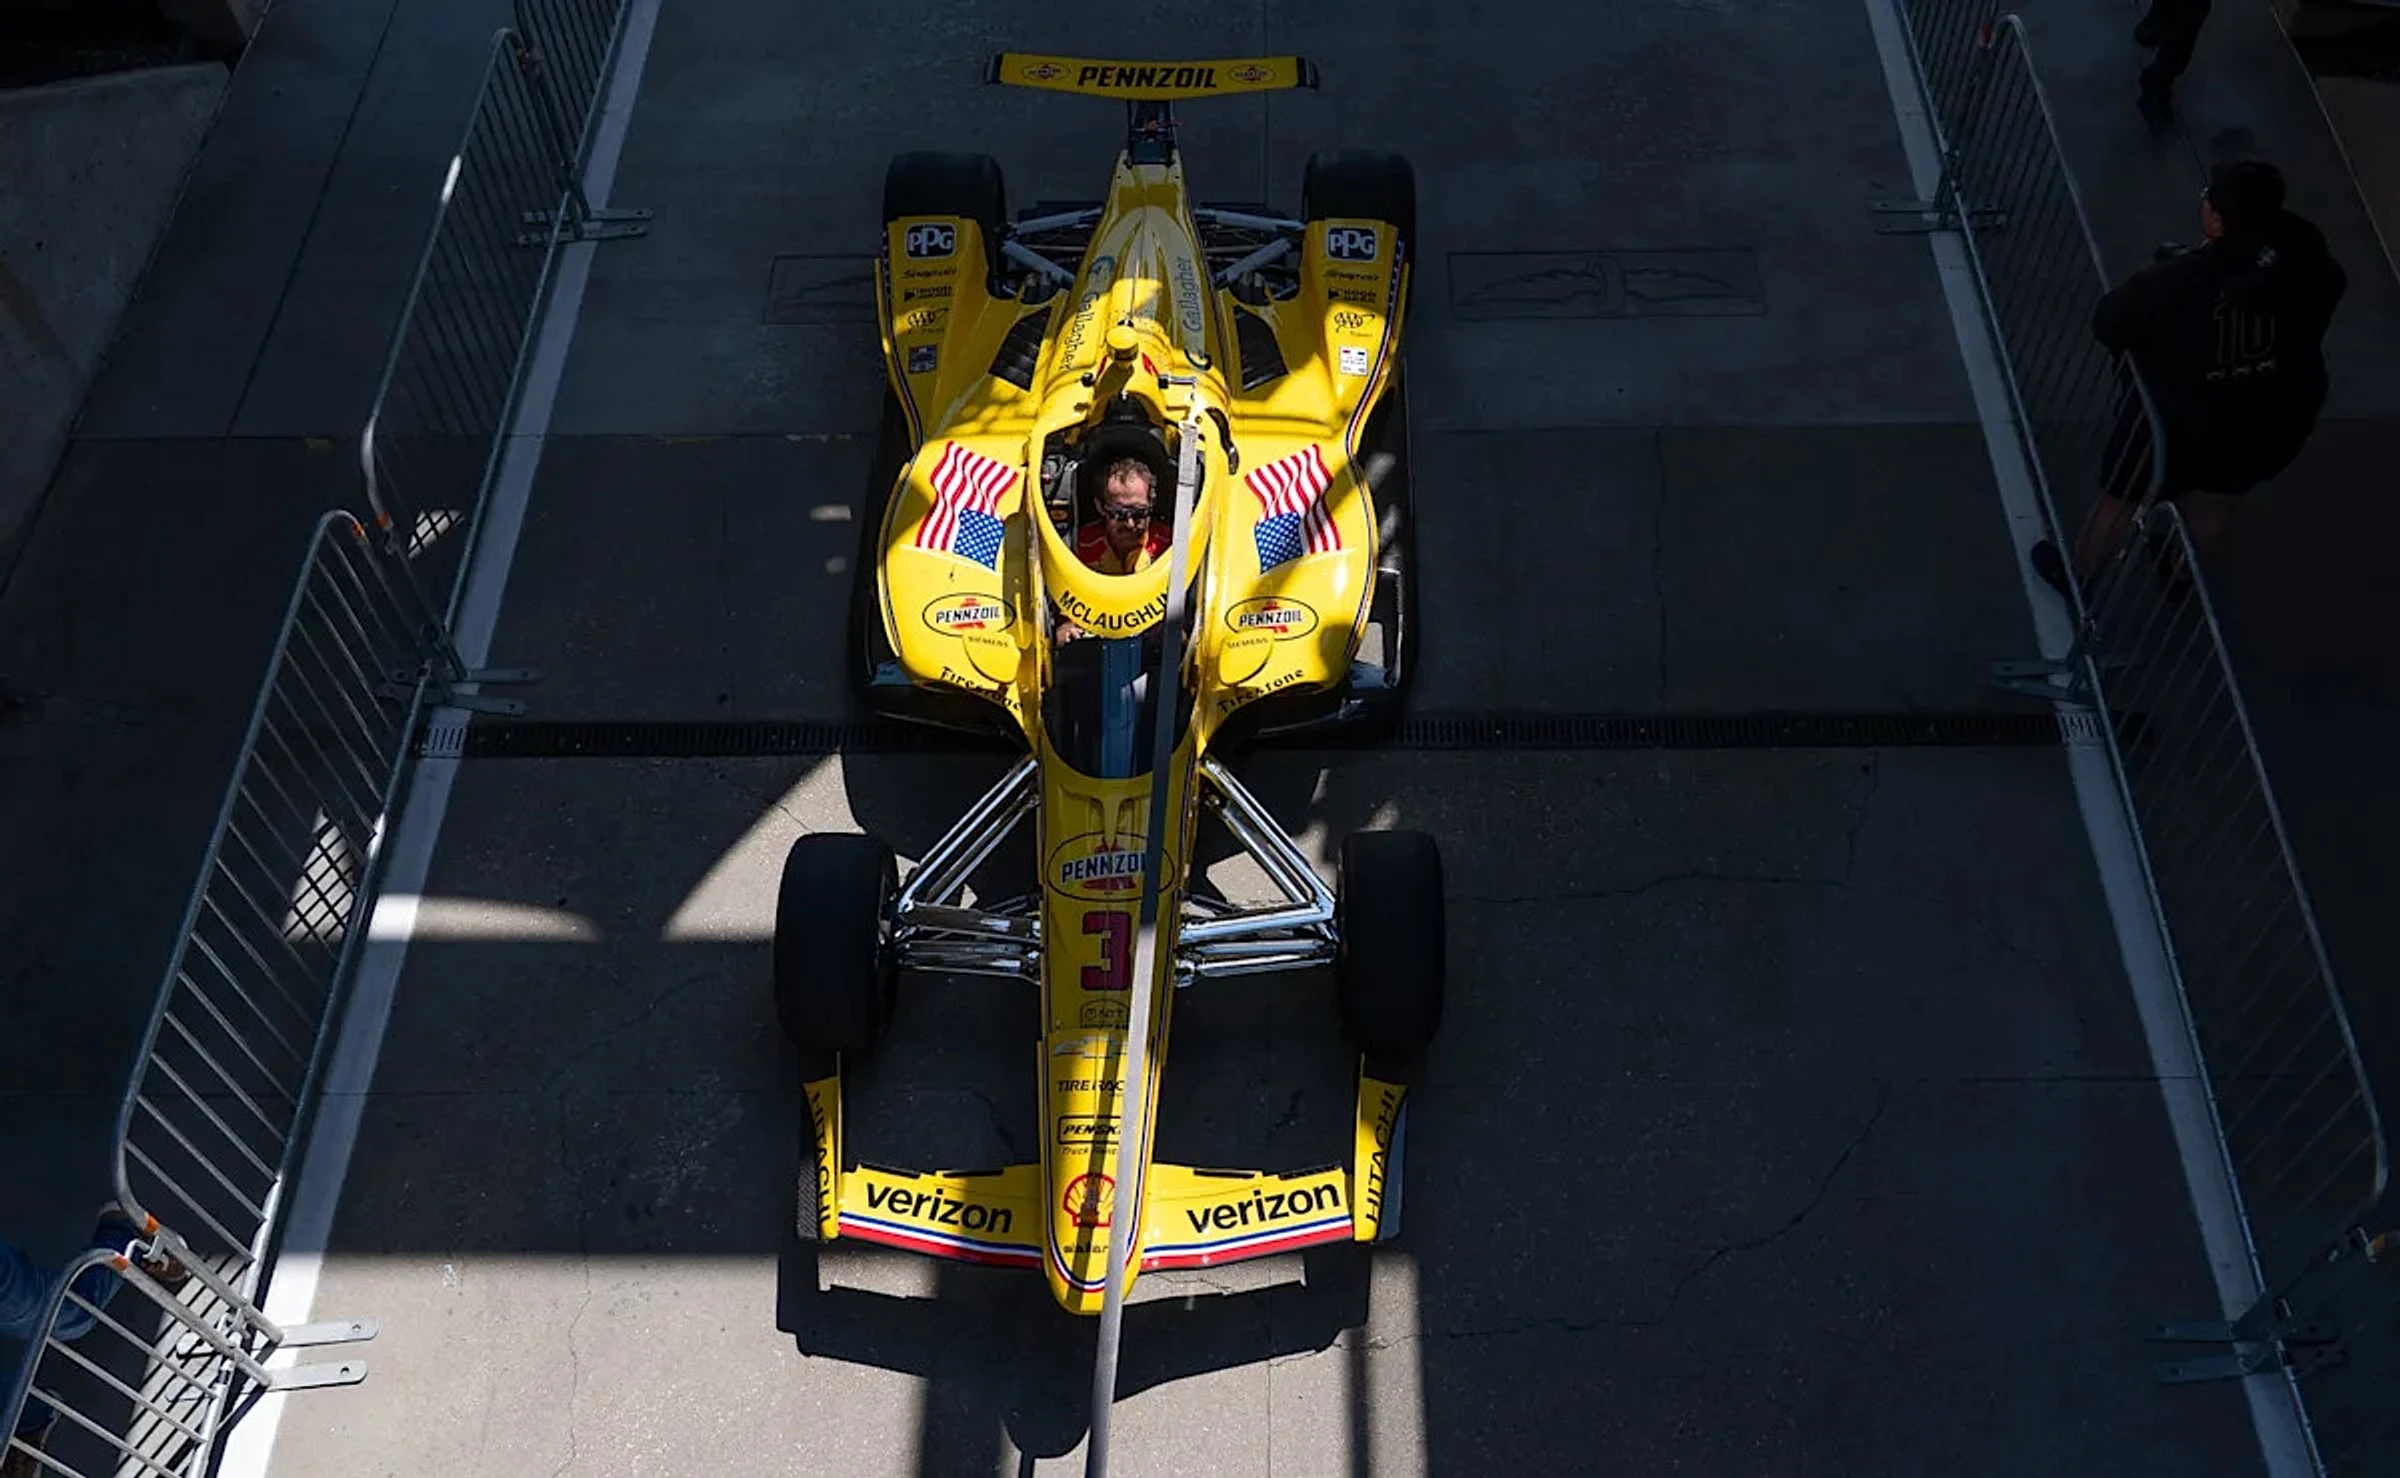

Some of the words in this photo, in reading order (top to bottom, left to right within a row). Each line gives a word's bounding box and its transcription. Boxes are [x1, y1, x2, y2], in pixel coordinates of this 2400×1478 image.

[1077, 66, 1217, 88] PENNZOIL
[908, 227, 953, 255] PPG
[1327, 230, 1375, 257] PPG
[1173, 256, 1203, 332] Gallagher
[1059, 291, 1100, 371] Gallagher
[936, 606, 1000, 624] PENNZOIL
[1059, 590, 1168, 630] MCLAUGHLI
[1239, 609, 1302, 627] PENNZOIL
[1060, 853, 1147, 884] PENNZOI
[1081, 911, 1131, 991] 3
[1057, 1080, 1090, 1092] TIRE
[1092, 1080, 1125, 1092] RAC
[1063, 1124, 1121, 1135] PENSK
[1365, 1089, 1396, 1224] HITACHI
[866, 1182, 1013, 1234] verizon
[1186, 1183, 1341, 1234] verizon
